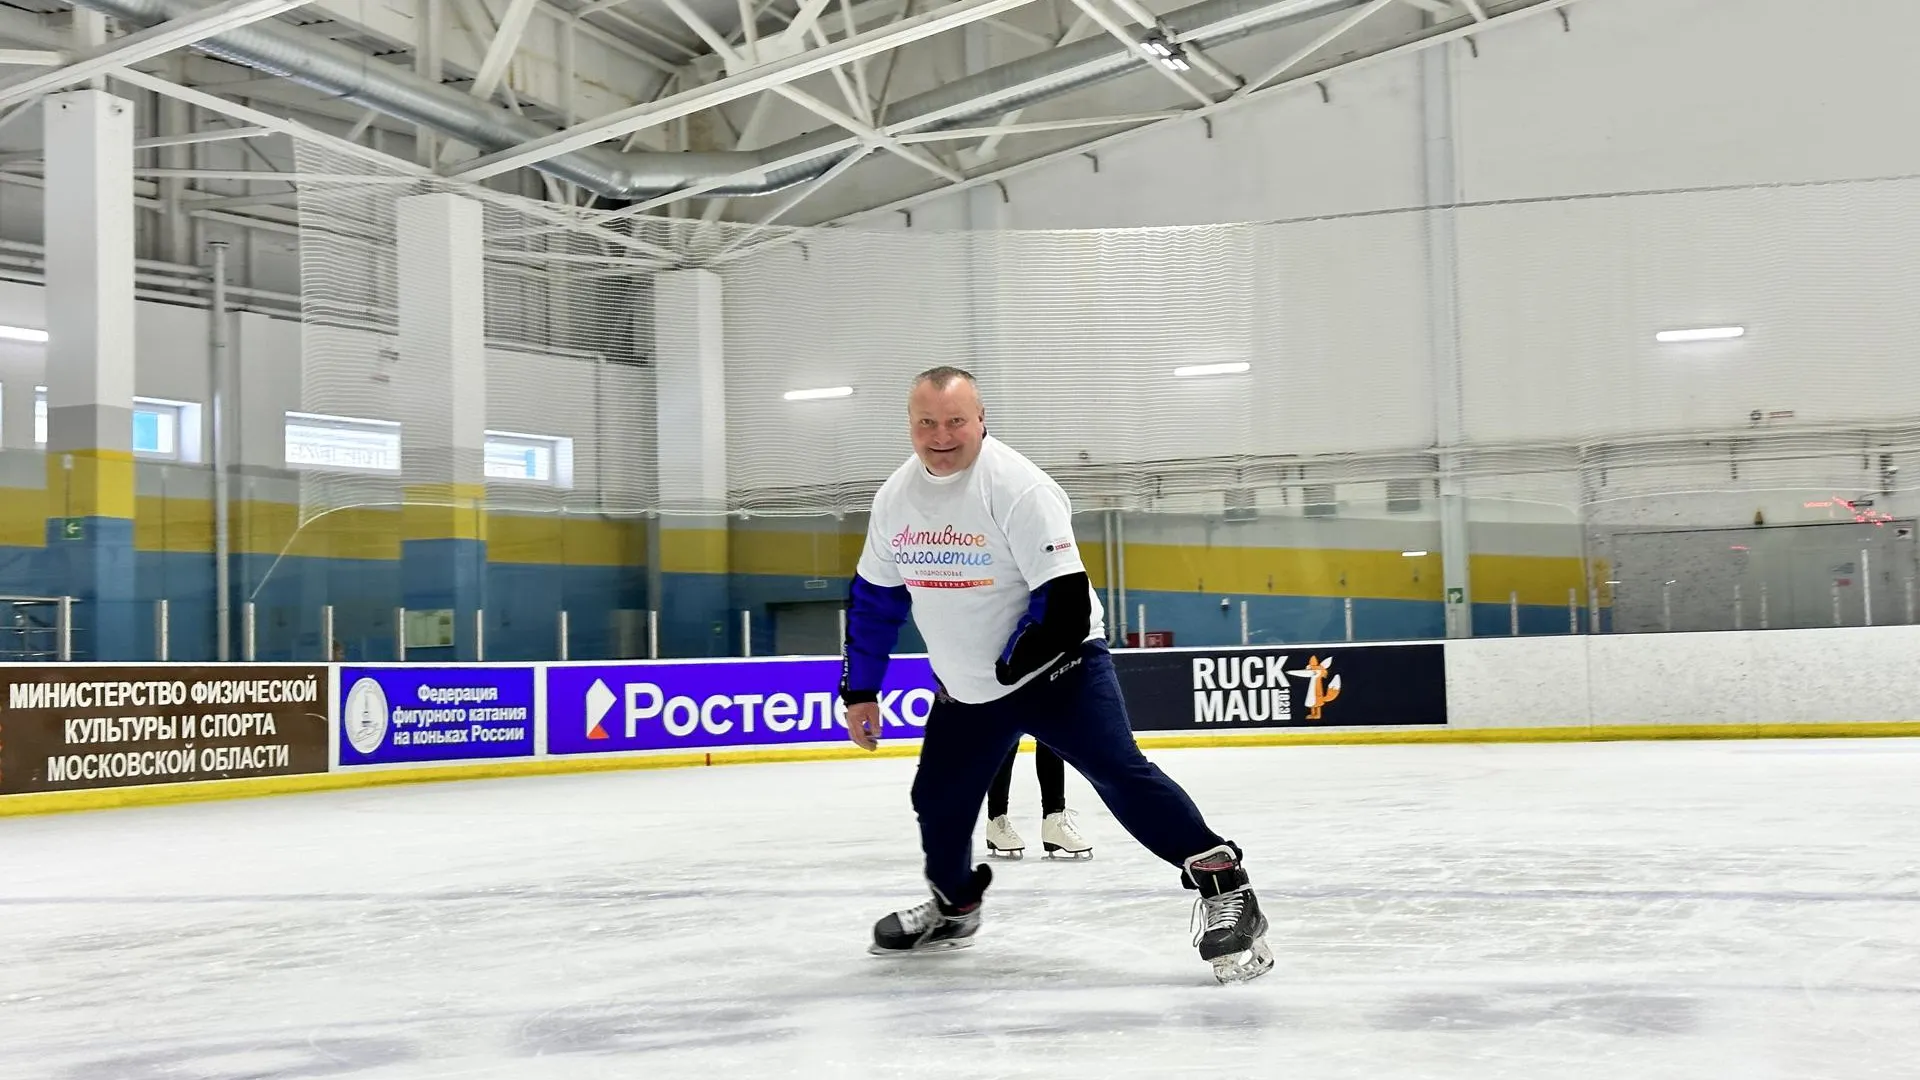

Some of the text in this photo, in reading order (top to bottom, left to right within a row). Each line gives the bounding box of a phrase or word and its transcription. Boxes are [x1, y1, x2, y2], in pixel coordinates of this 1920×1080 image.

[892, 524, 987, 548] Активное
[894, 545, 993, 566] долголетие
[1050, 656, 1082, 681] CCM
[1193, 656, 1291, 689] RUCK
[9, 674, 317, 709] МИНИСТЕРСТВО ФИЗИЧЕСКОЙ
[417, 684, 498, 705] Федерация
[392, 706, 527, 728] фигурного катания
[1194, 689, 1292, 723] MAUL
[65, 712, 276, 744] КУЛЬТУРЫ И СПОРТА
[393, 725, 525, 745] на коньках России
[47, 743, 289, 781] МОСКОВСКОЙ ОБЛАСТИ
